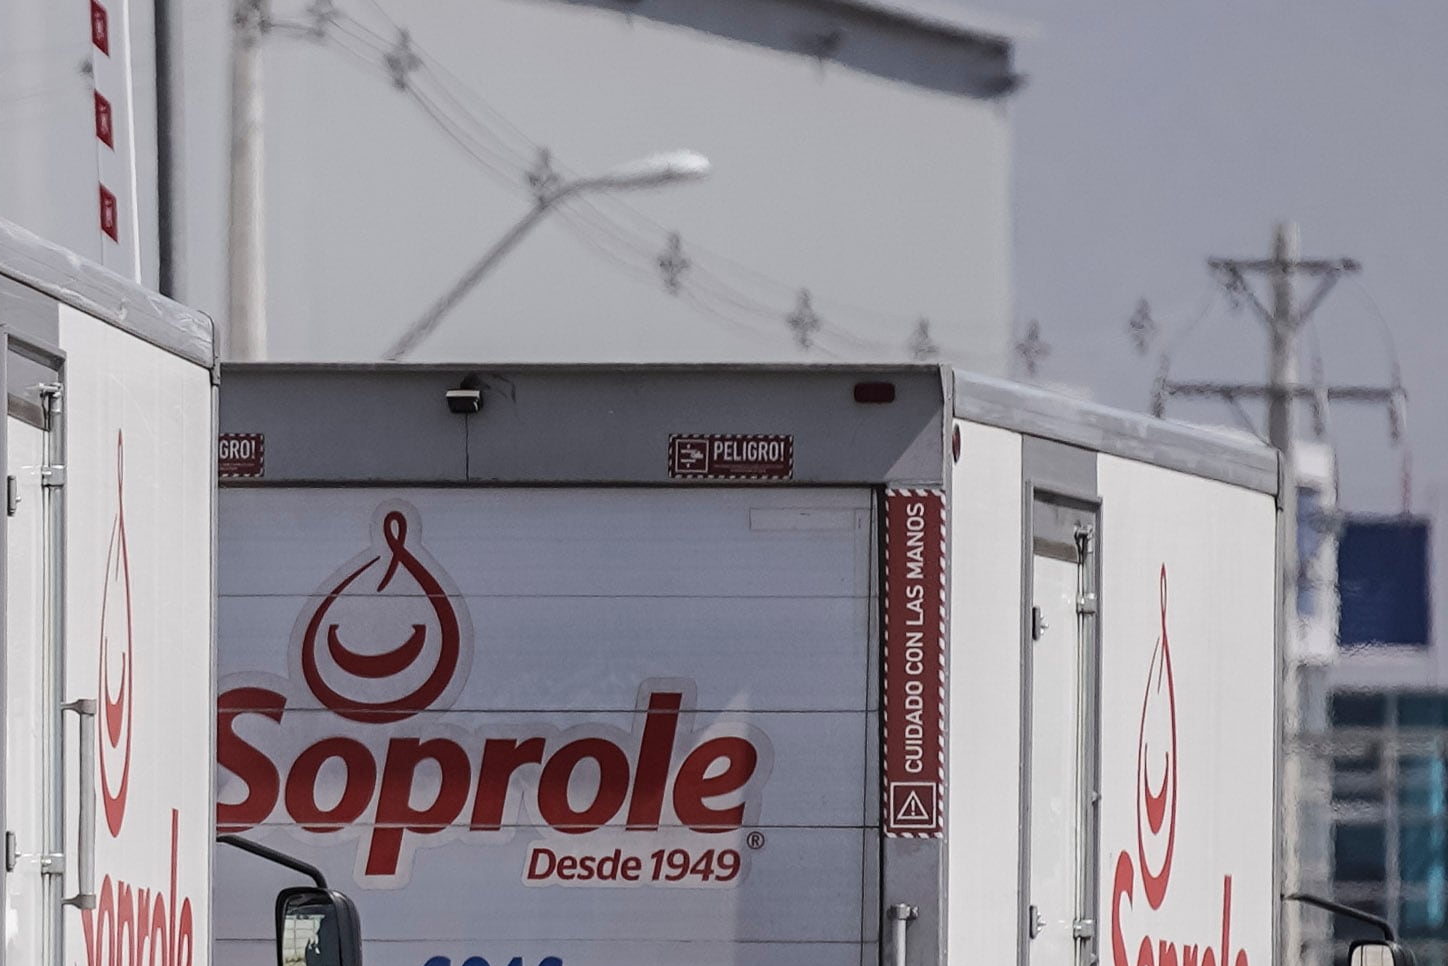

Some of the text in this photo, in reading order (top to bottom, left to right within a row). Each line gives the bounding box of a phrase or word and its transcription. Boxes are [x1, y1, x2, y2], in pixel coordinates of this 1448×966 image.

[713, 441, 785, 462] PELIGRO!
[904, 502, 924, 773] CUIDADO CON LAS MANOS
[527, 847, 740, 881] Desde 1949
